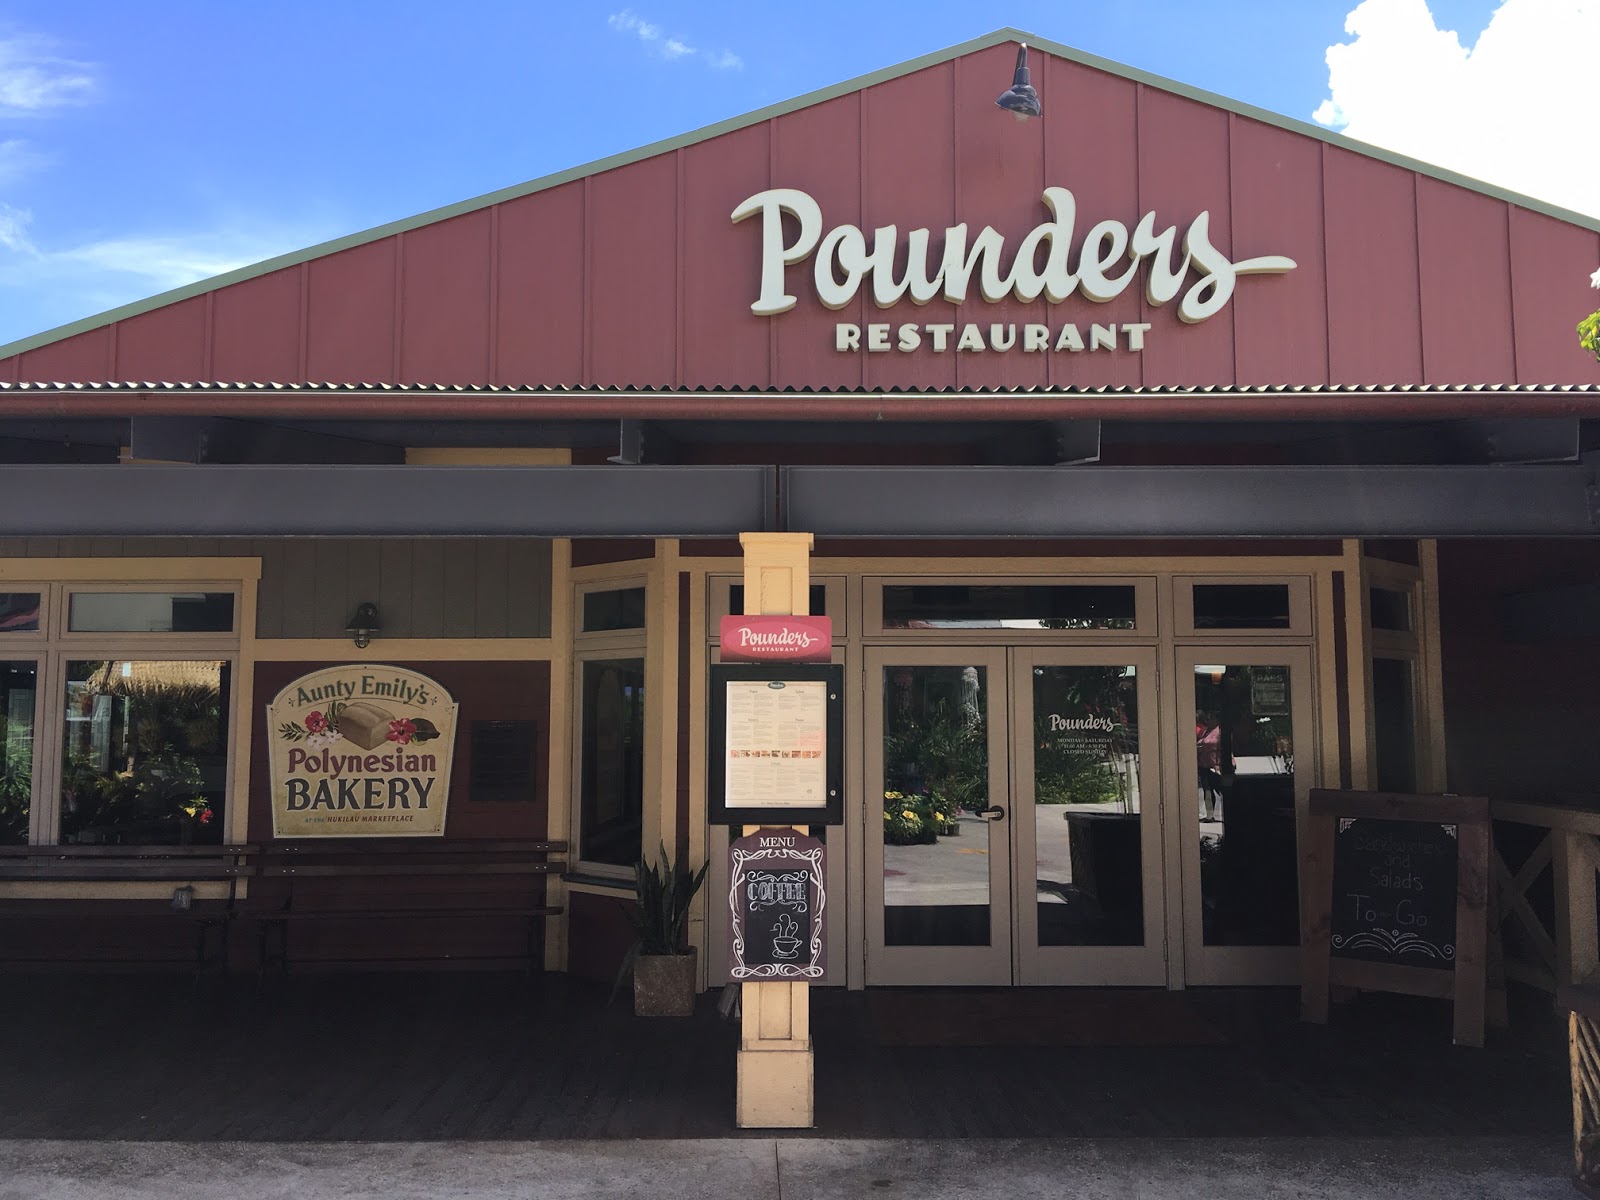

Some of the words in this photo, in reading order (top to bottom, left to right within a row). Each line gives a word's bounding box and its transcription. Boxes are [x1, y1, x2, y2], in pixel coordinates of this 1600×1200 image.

[730, 186, 1297, 324] Pounders
[836, 322, 1152, 352] RESTAURANT
[738, 627, 819, 648] Pounders
[297, 679, 356, 707] Aunty
[361, 675, 431, 706] Emily's
[1049, 713, 1122, 733] Pounders
[287, 747, 437, 780] Polynesian
[284, 777, 436, 811] BAKERY
[326, 815, 360, 823] HUKILAU
[361, 815, 414, 823] MARKETPLACE
[759, 837, 796, 847] MENU
[1384, 854, 1410, 868] and
[1369, 866, 1423, 891] Salads
[747, 881, 807, 901] COFFEE
